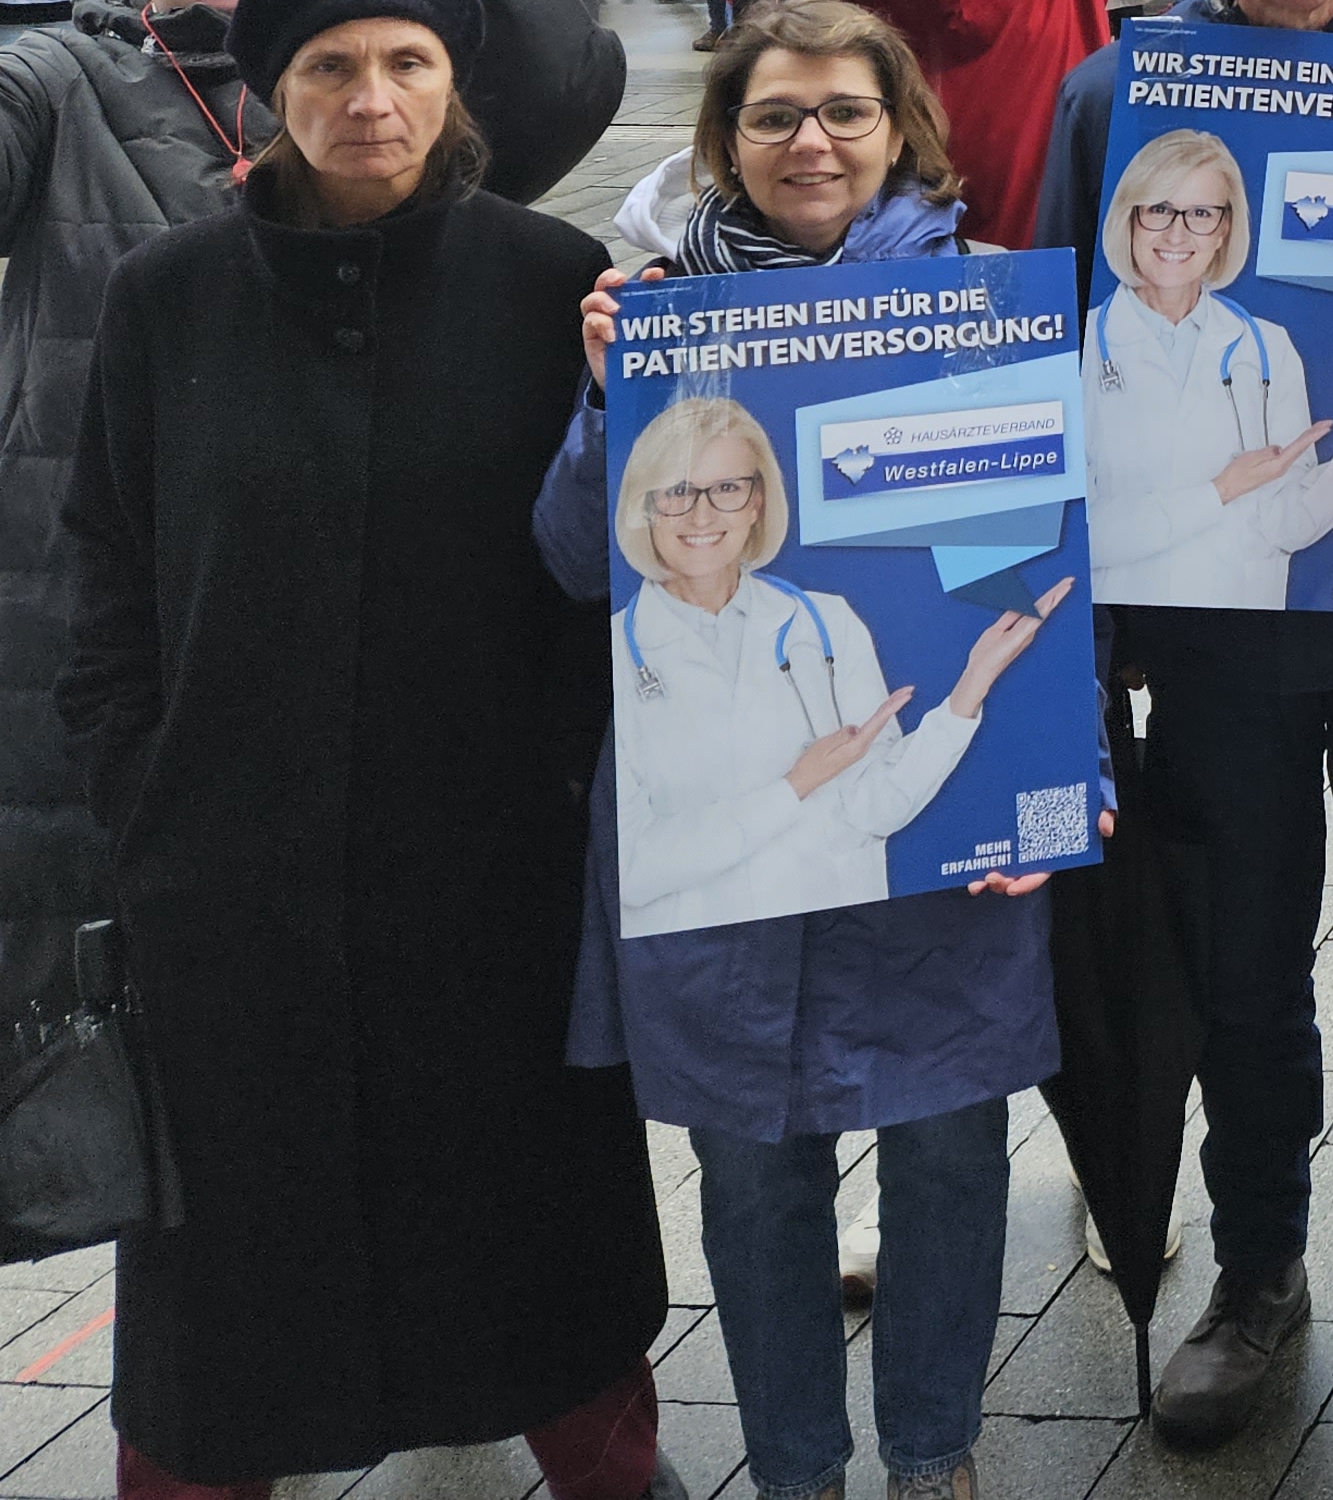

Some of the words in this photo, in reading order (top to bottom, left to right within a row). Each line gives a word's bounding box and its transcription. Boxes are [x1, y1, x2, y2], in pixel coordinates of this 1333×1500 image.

[621, 315, 682, 341] WIR
[690, 303, 807, 334] STEHEN
[816, 297, 867, 323] EIN
[873, 288, 937, 320] FÜR
[941, 288, 985, 315] DIE
[623, 314, 1063, 378] PATIENTENVERSORGUNG!
[911, 417, 1054, 443] HAUSÄRZTEVERBAND
[884, 450, 1057, 483] Westfalen-Lippe
